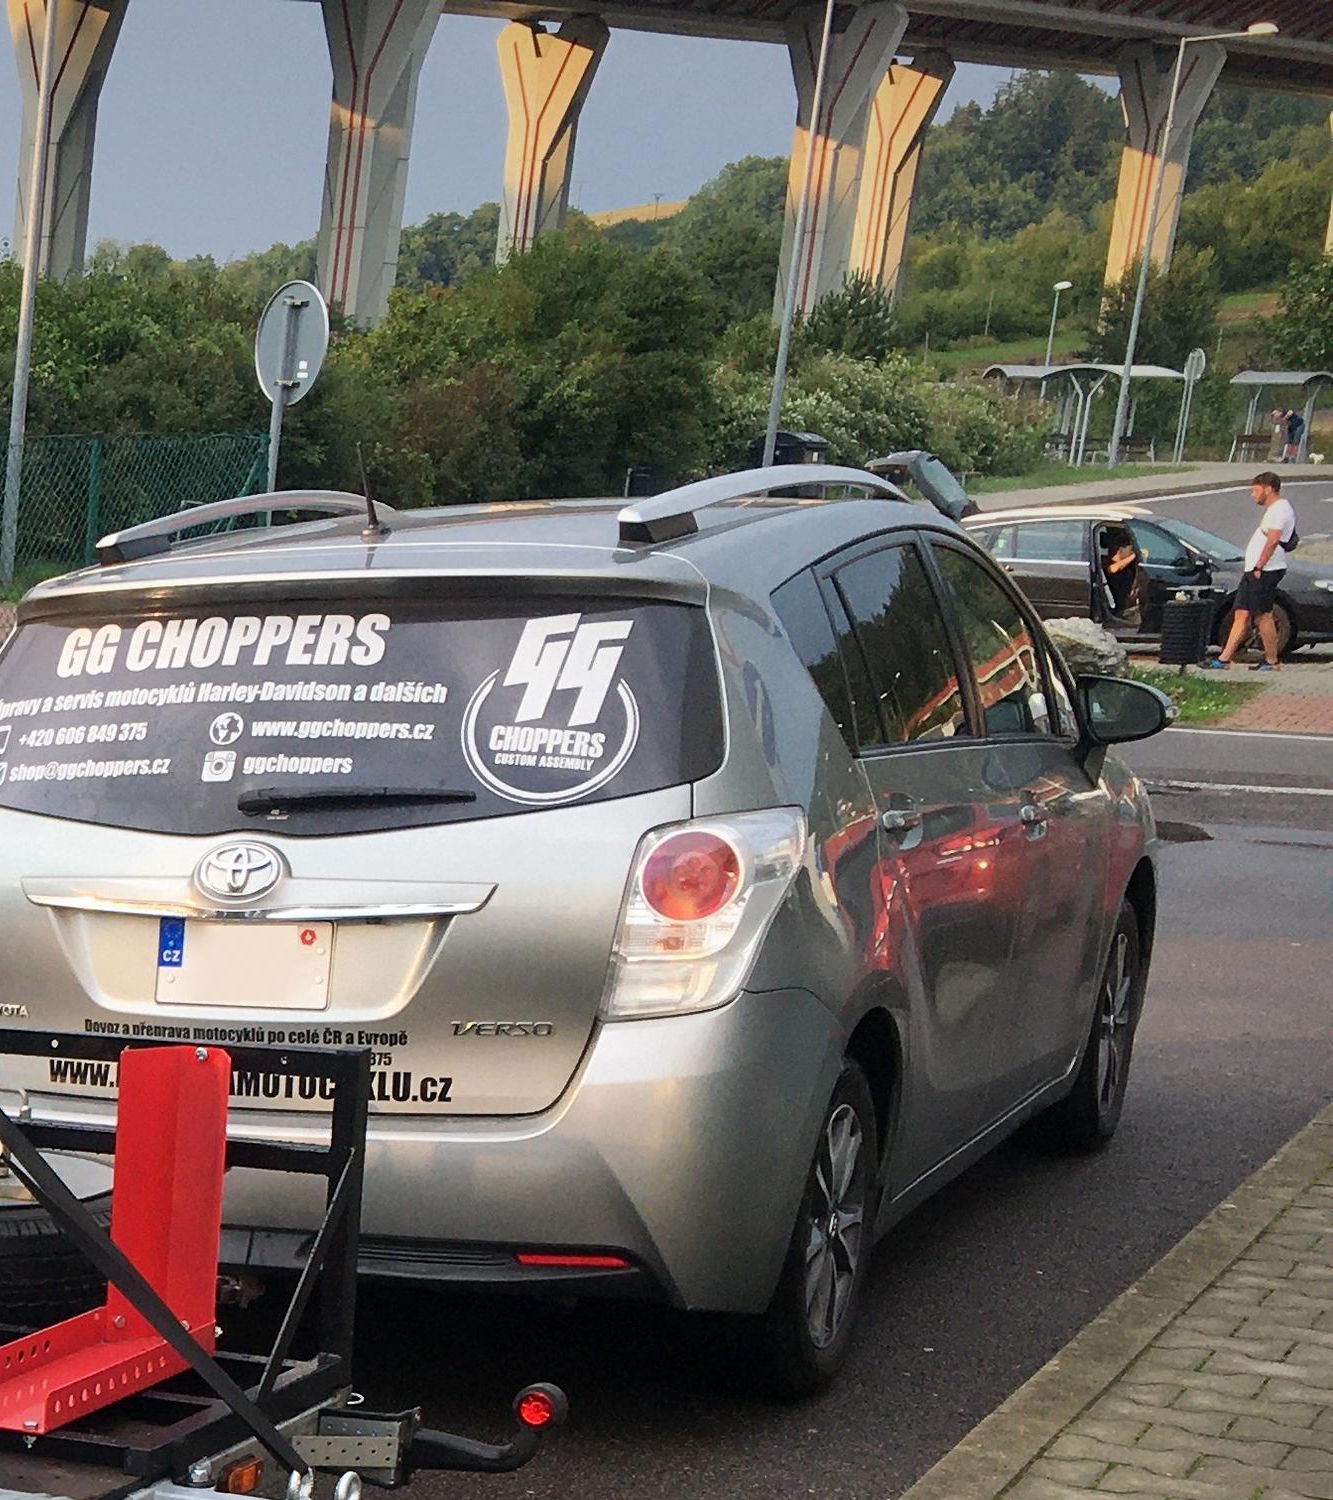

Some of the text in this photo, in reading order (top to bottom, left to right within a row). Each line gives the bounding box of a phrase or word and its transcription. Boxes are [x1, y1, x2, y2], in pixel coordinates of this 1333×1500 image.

[56, 613, 391, 678] GG CHOPPERS
[41, 696, 51, 712] a
[53, 690, 104, 712] servis
[106, 681, 195, 708] motocyklů
[197, 681, 351, 703] Harley-Davidson
[353, 686, 367, 701] a
[369, 681, 448, 704] dalších
[18, 721, 148, 748] +420 606 849 375
[251, 719, 435, 740] www.ggchoppers.cz
[489, 725, 606, 758] CHOPPERS
[8, 757, 172, 782] shop@ggchoppers.cz
[242, 754, 353, 775] ggchoppers
[494, 752, 595, 772] CUSTOM ASSEMBLY
[162, 950, 180, 962] CZ
[84, 1018, 121, 1034] Dovoz
[122, 1023, 130, 1035] a
[193, 1025, 264, 1043] motocyklů
[267, 1031, 285, 1045] po
[288, 1028, 320, 1044] celé
[323, 1027, 342, 1045] ČR
[345, 1033, 354, 1045] a
[357, 1029, 408, 1048] Evropě
[451, 1020, 554, 1037] VERSO
